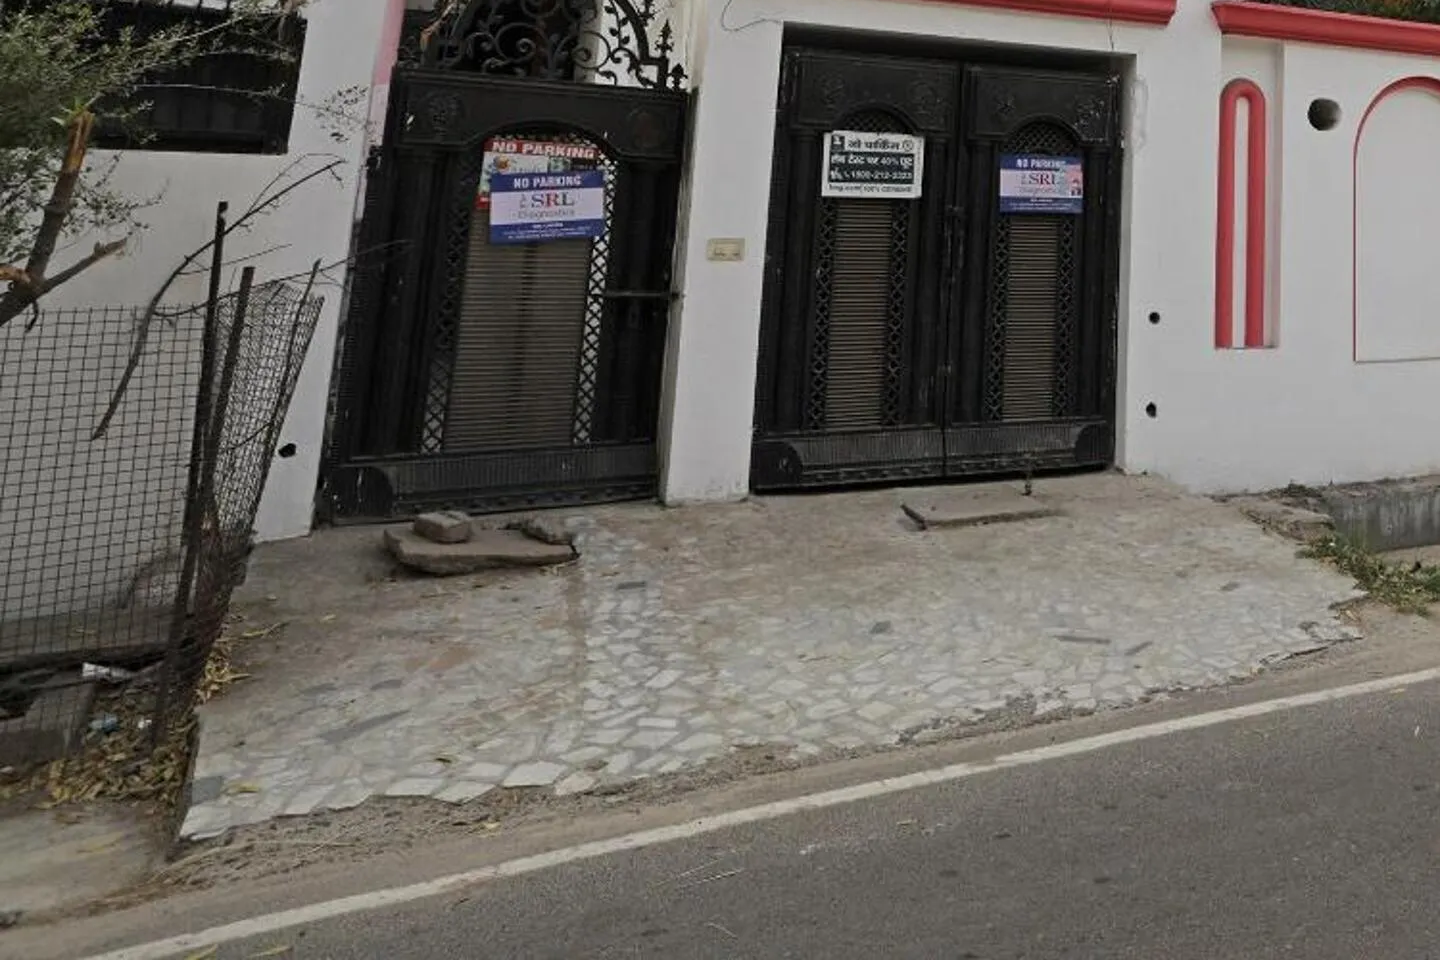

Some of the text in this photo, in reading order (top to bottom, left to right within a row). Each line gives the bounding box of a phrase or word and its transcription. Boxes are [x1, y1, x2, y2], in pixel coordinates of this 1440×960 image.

[492, 141, 595, 159] NO PARKING
[513, 175, 582, 189] NO PARKING
[531, 191, 575, 209] SRL
